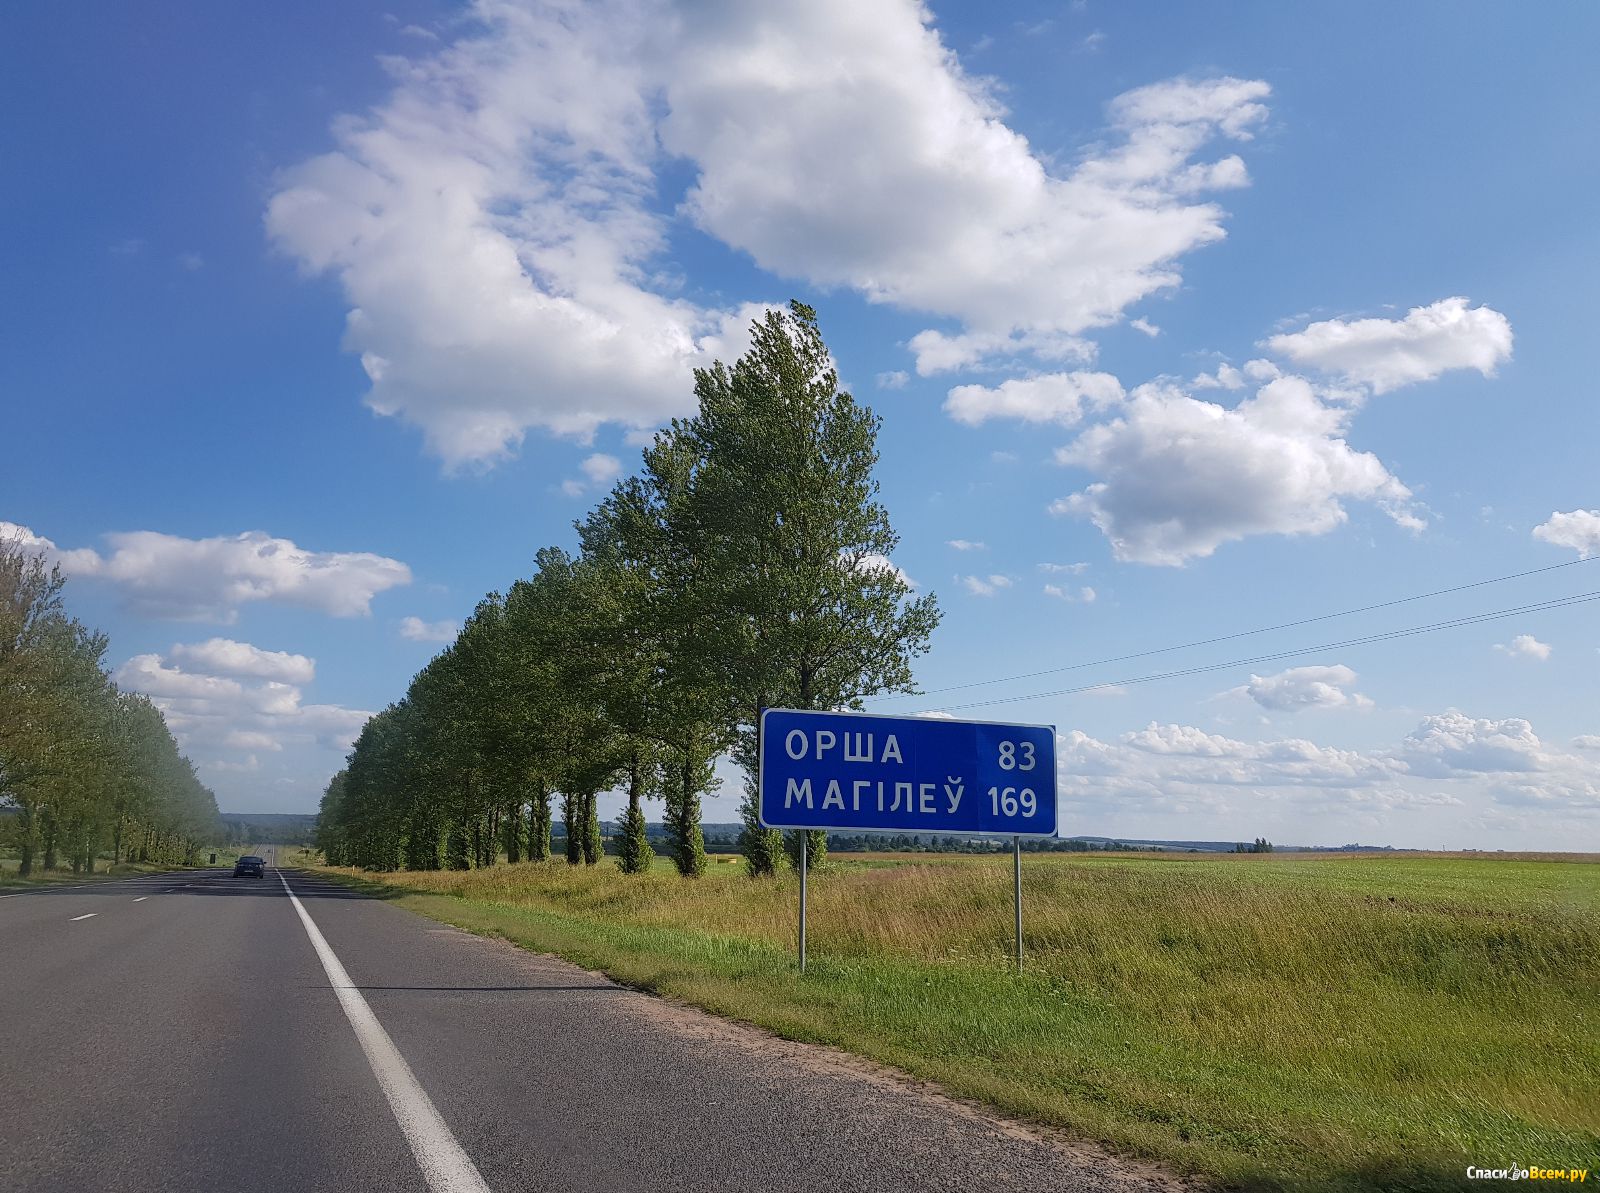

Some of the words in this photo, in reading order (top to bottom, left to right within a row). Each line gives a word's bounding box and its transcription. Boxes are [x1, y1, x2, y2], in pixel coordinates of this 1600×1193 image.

[785, 729, 903, 764] ОРША
[998, 740, 1036, 771] 83
[784, 775, 965, 814] МАГІЛЕЎ
[987, 786, 1037, 818] 169
